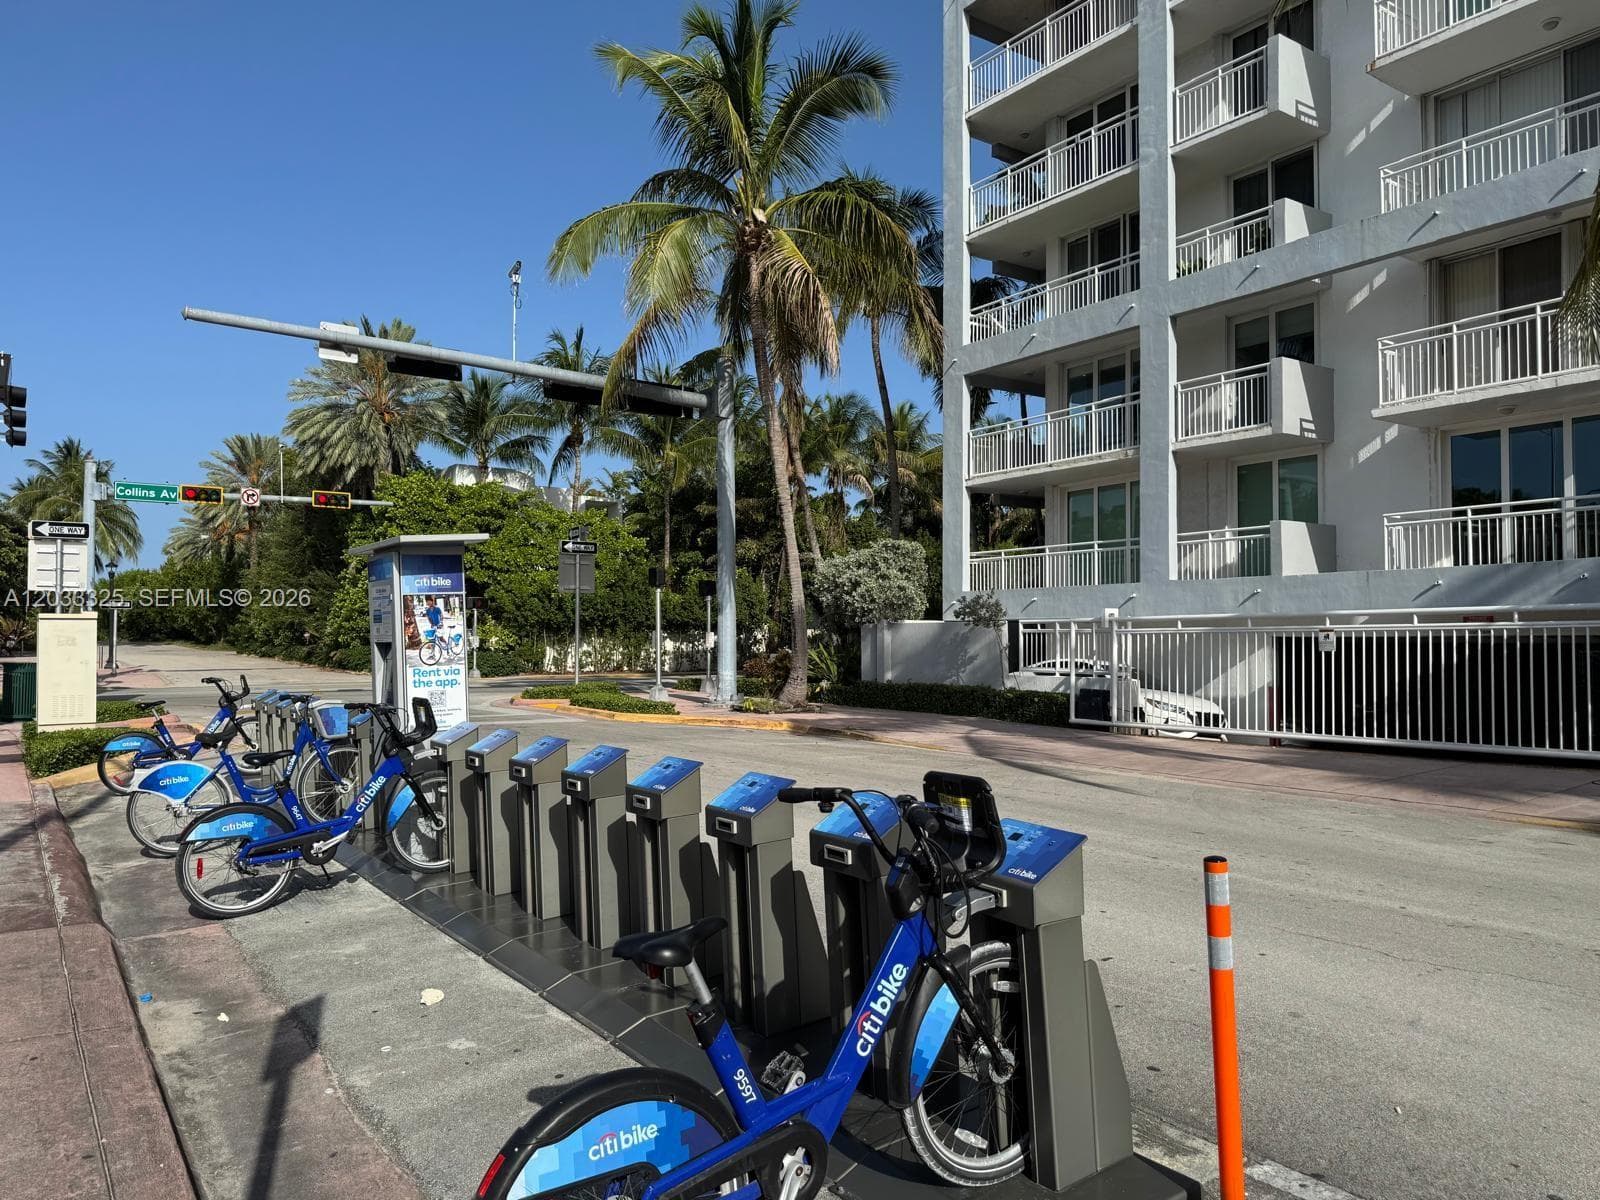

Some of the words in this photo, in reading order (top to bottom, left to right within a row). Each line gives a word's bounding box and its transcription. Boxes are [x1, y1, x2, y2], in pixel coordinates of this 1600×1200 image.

[116, 486, 156, 498] Collins
[160, 489, 177, 499] Av
[414, 577, 430, 586] citi
[431, 576, 452, 586] bike
[412, 667, 441, 678] Rent
[443, 666, 461, 676] via
[413, 678, 433, 688] the
[435, 678, 461, 689] app.
[159, 777, 172, 786] citi
[172, 775, 189, 784] bike
[355, 793, 371, 812] citi
[364, 775, 386, 797] bike
[221, 823, 236, 832] citi
[236, 820, 255, 830] bike
[869, 963, 908, 1017] bike
[856, 1012, 883, 1057] citi
[733, 1068, 757, 1104] 9597
[588, 1133, 618, 1161] citi
[619, 1123, 659, 1150] bike
